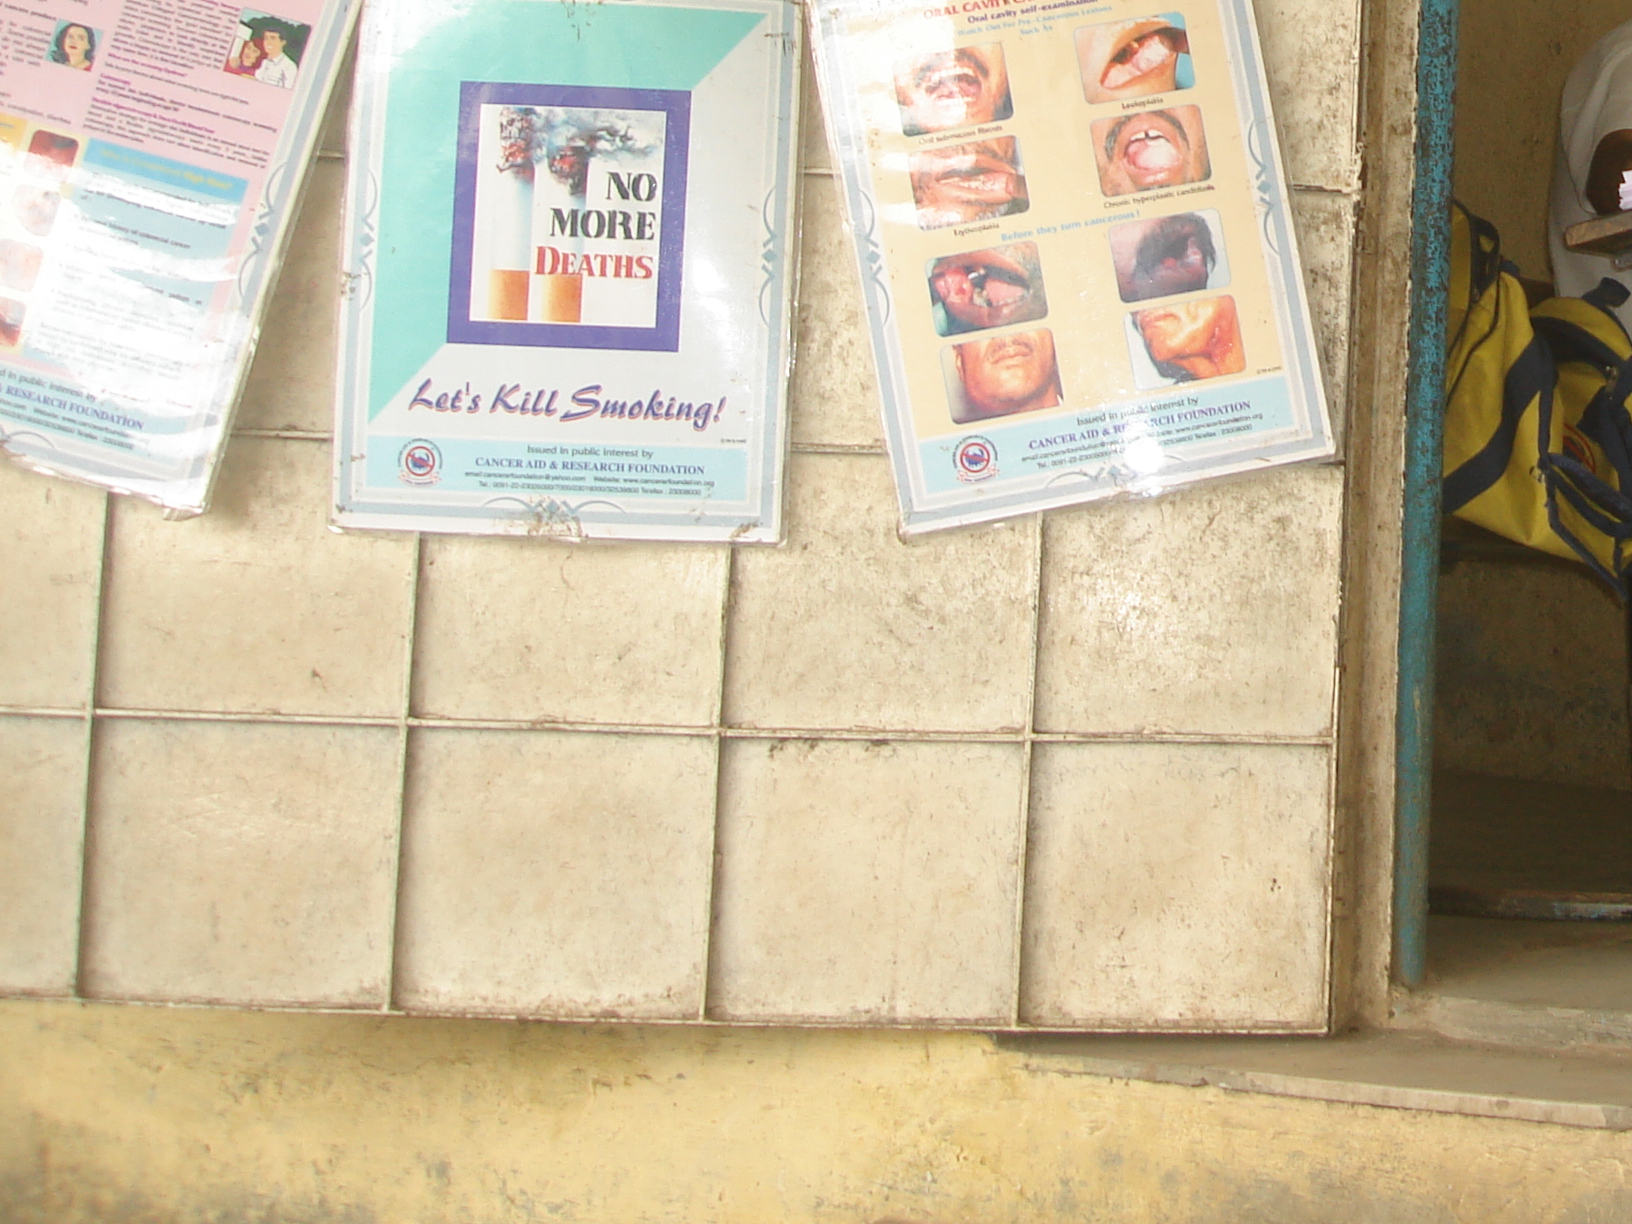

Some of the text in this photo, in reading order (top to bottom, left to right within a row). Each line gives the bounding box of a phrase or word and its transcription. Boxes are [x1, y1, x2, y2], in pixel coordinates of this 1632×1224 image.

[967, 14, 988, 23] Oral
[991, 9, 1017, 20] cavity
[606, 171, 657, 202] NO
[550, 208, 656, 240] MORE
[1001, 228, 1033, 241] Before
[1036, 223, 1057, 236] they
[6, 385, 67, 410] RESEARCH
[69, 402, 144, 430] FOUNDATION
[408, 377, 727, 432] Let's Kill Smoking!
[1029, 401, 1251, 451] CANCER AID & FOUNDATION
[475, 457, 706, 475] CANCER AID & RESEARCH FOUNDATION
[527, 444, 557, 456] Issued
[570, 447, 601, 459] public
[641, 449, 654, 460] by
